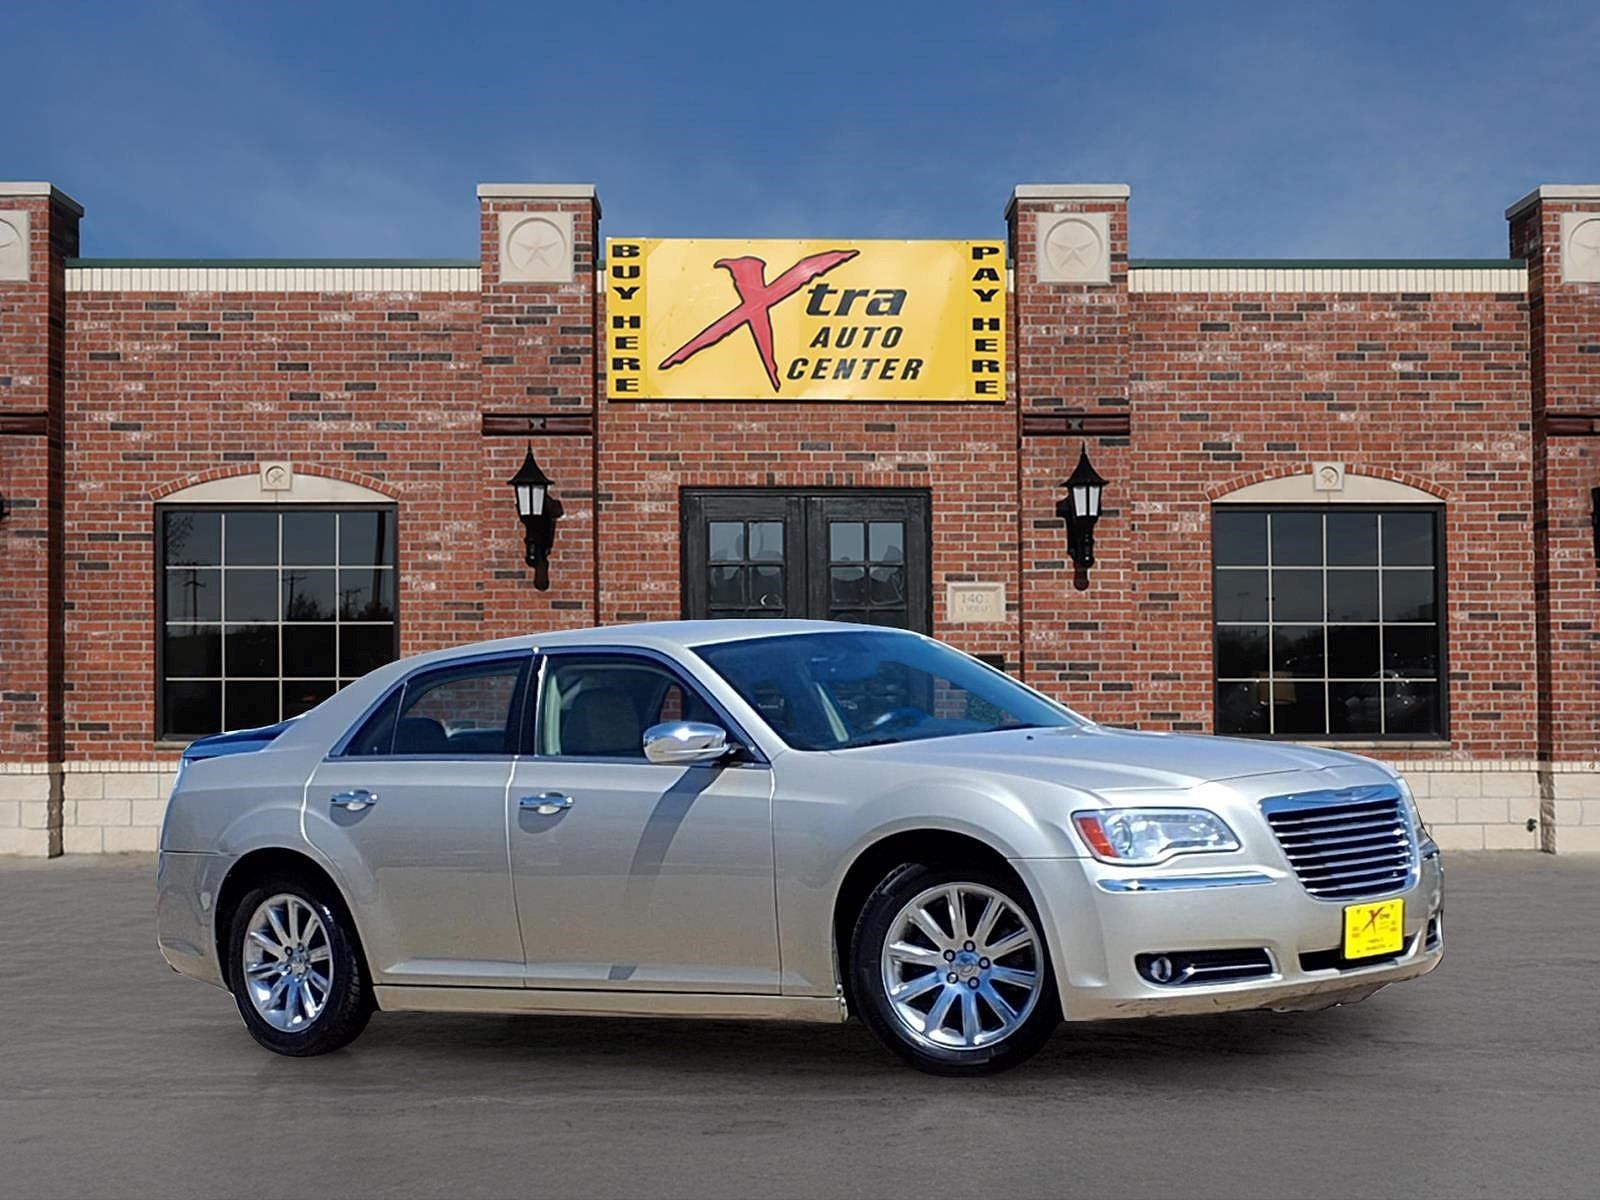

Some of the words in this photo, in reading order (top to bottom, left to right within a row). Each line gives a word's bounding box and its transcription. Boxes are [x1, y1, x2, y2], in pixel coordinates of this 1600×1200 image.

[612, 244, 640, 300] BUY
[972, 246, 1000, 302] PAY
[658, 250, 908, 392] Xtra
[809, 325, 903, 349] AUTO
[612, 315, 640, 392] HERE
[786, 357, 923, 381] CENTER
[972, 317, 1000, 394] HERE
